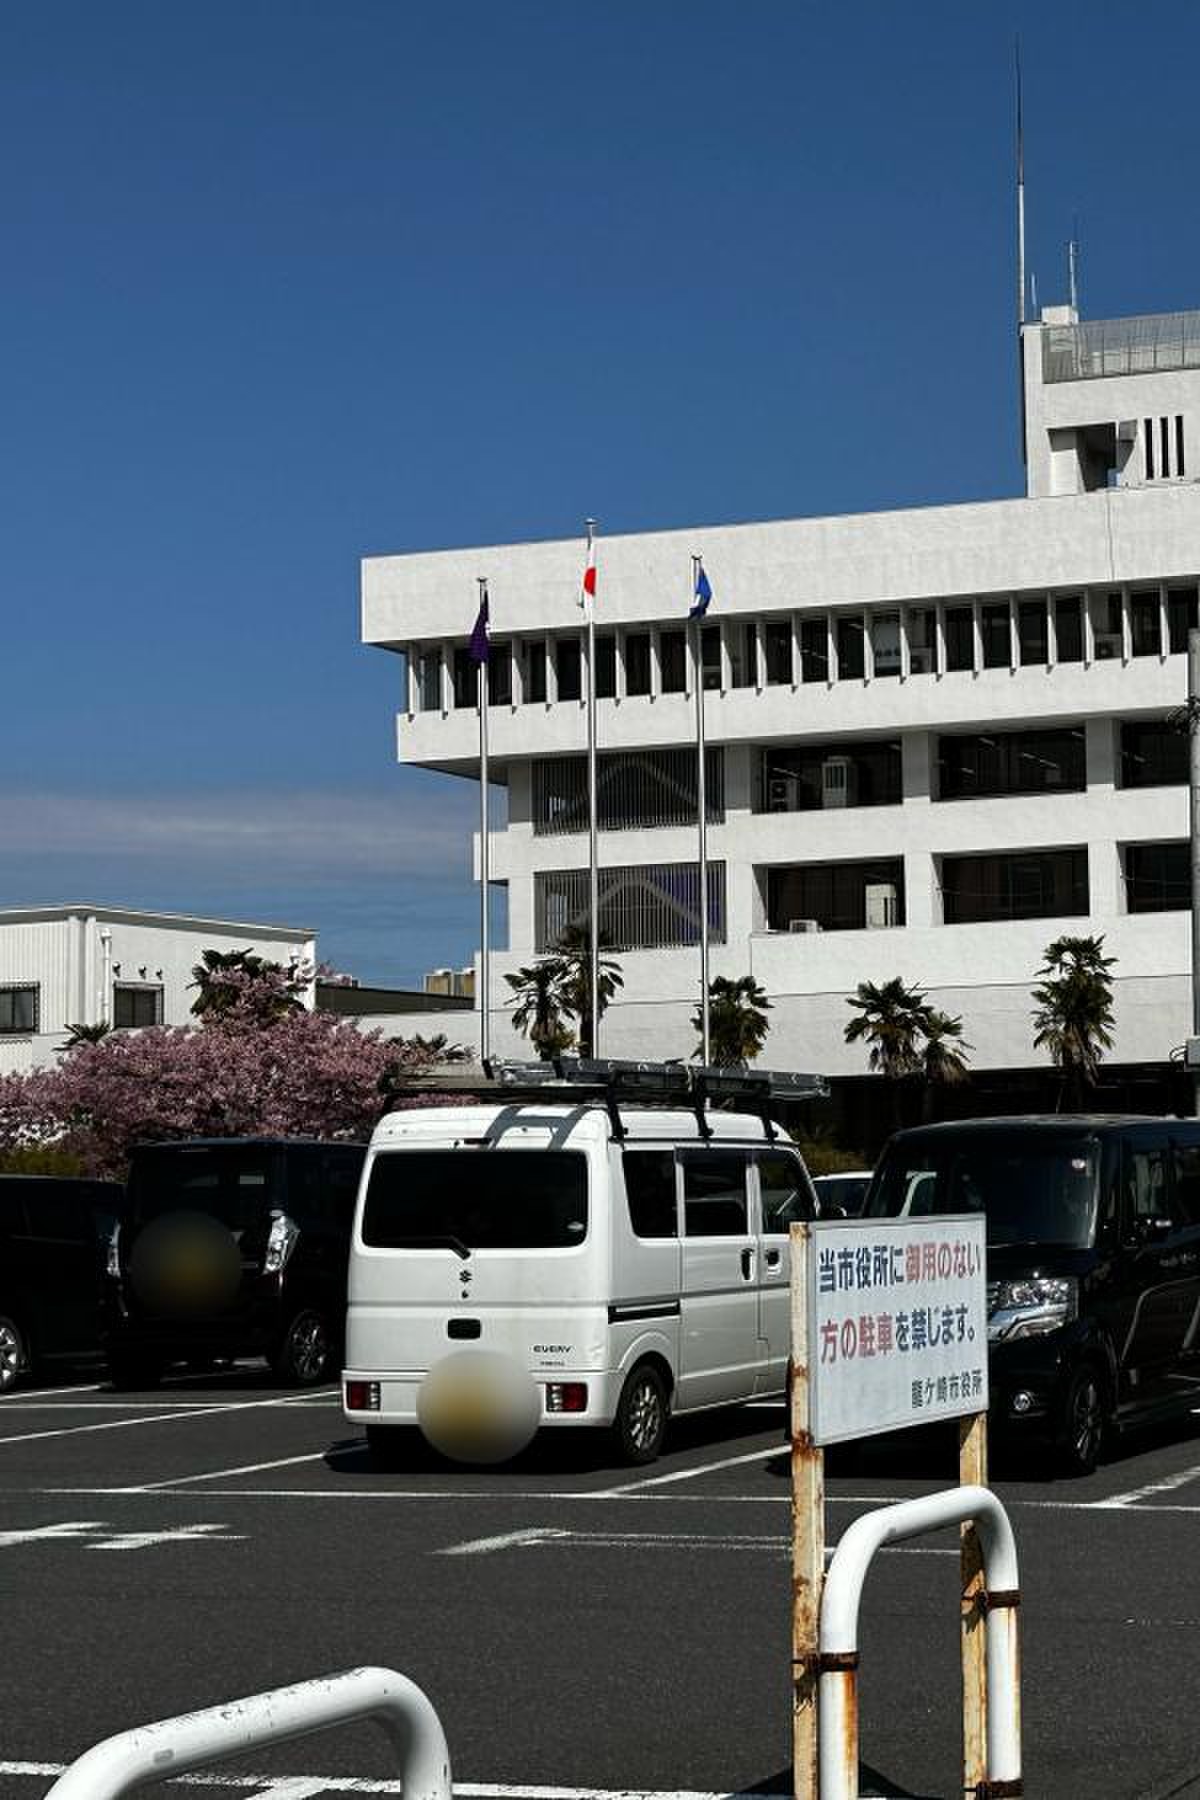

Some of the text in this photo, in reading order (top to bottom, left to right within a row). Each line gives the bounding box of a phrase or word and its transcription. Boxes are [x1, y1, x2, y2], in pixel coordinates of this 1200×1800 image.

[819, 1241, 981, 1293] 当市役所に御用のない
[820, 1303, 976, 1364] 方の駐車を禁じます。
